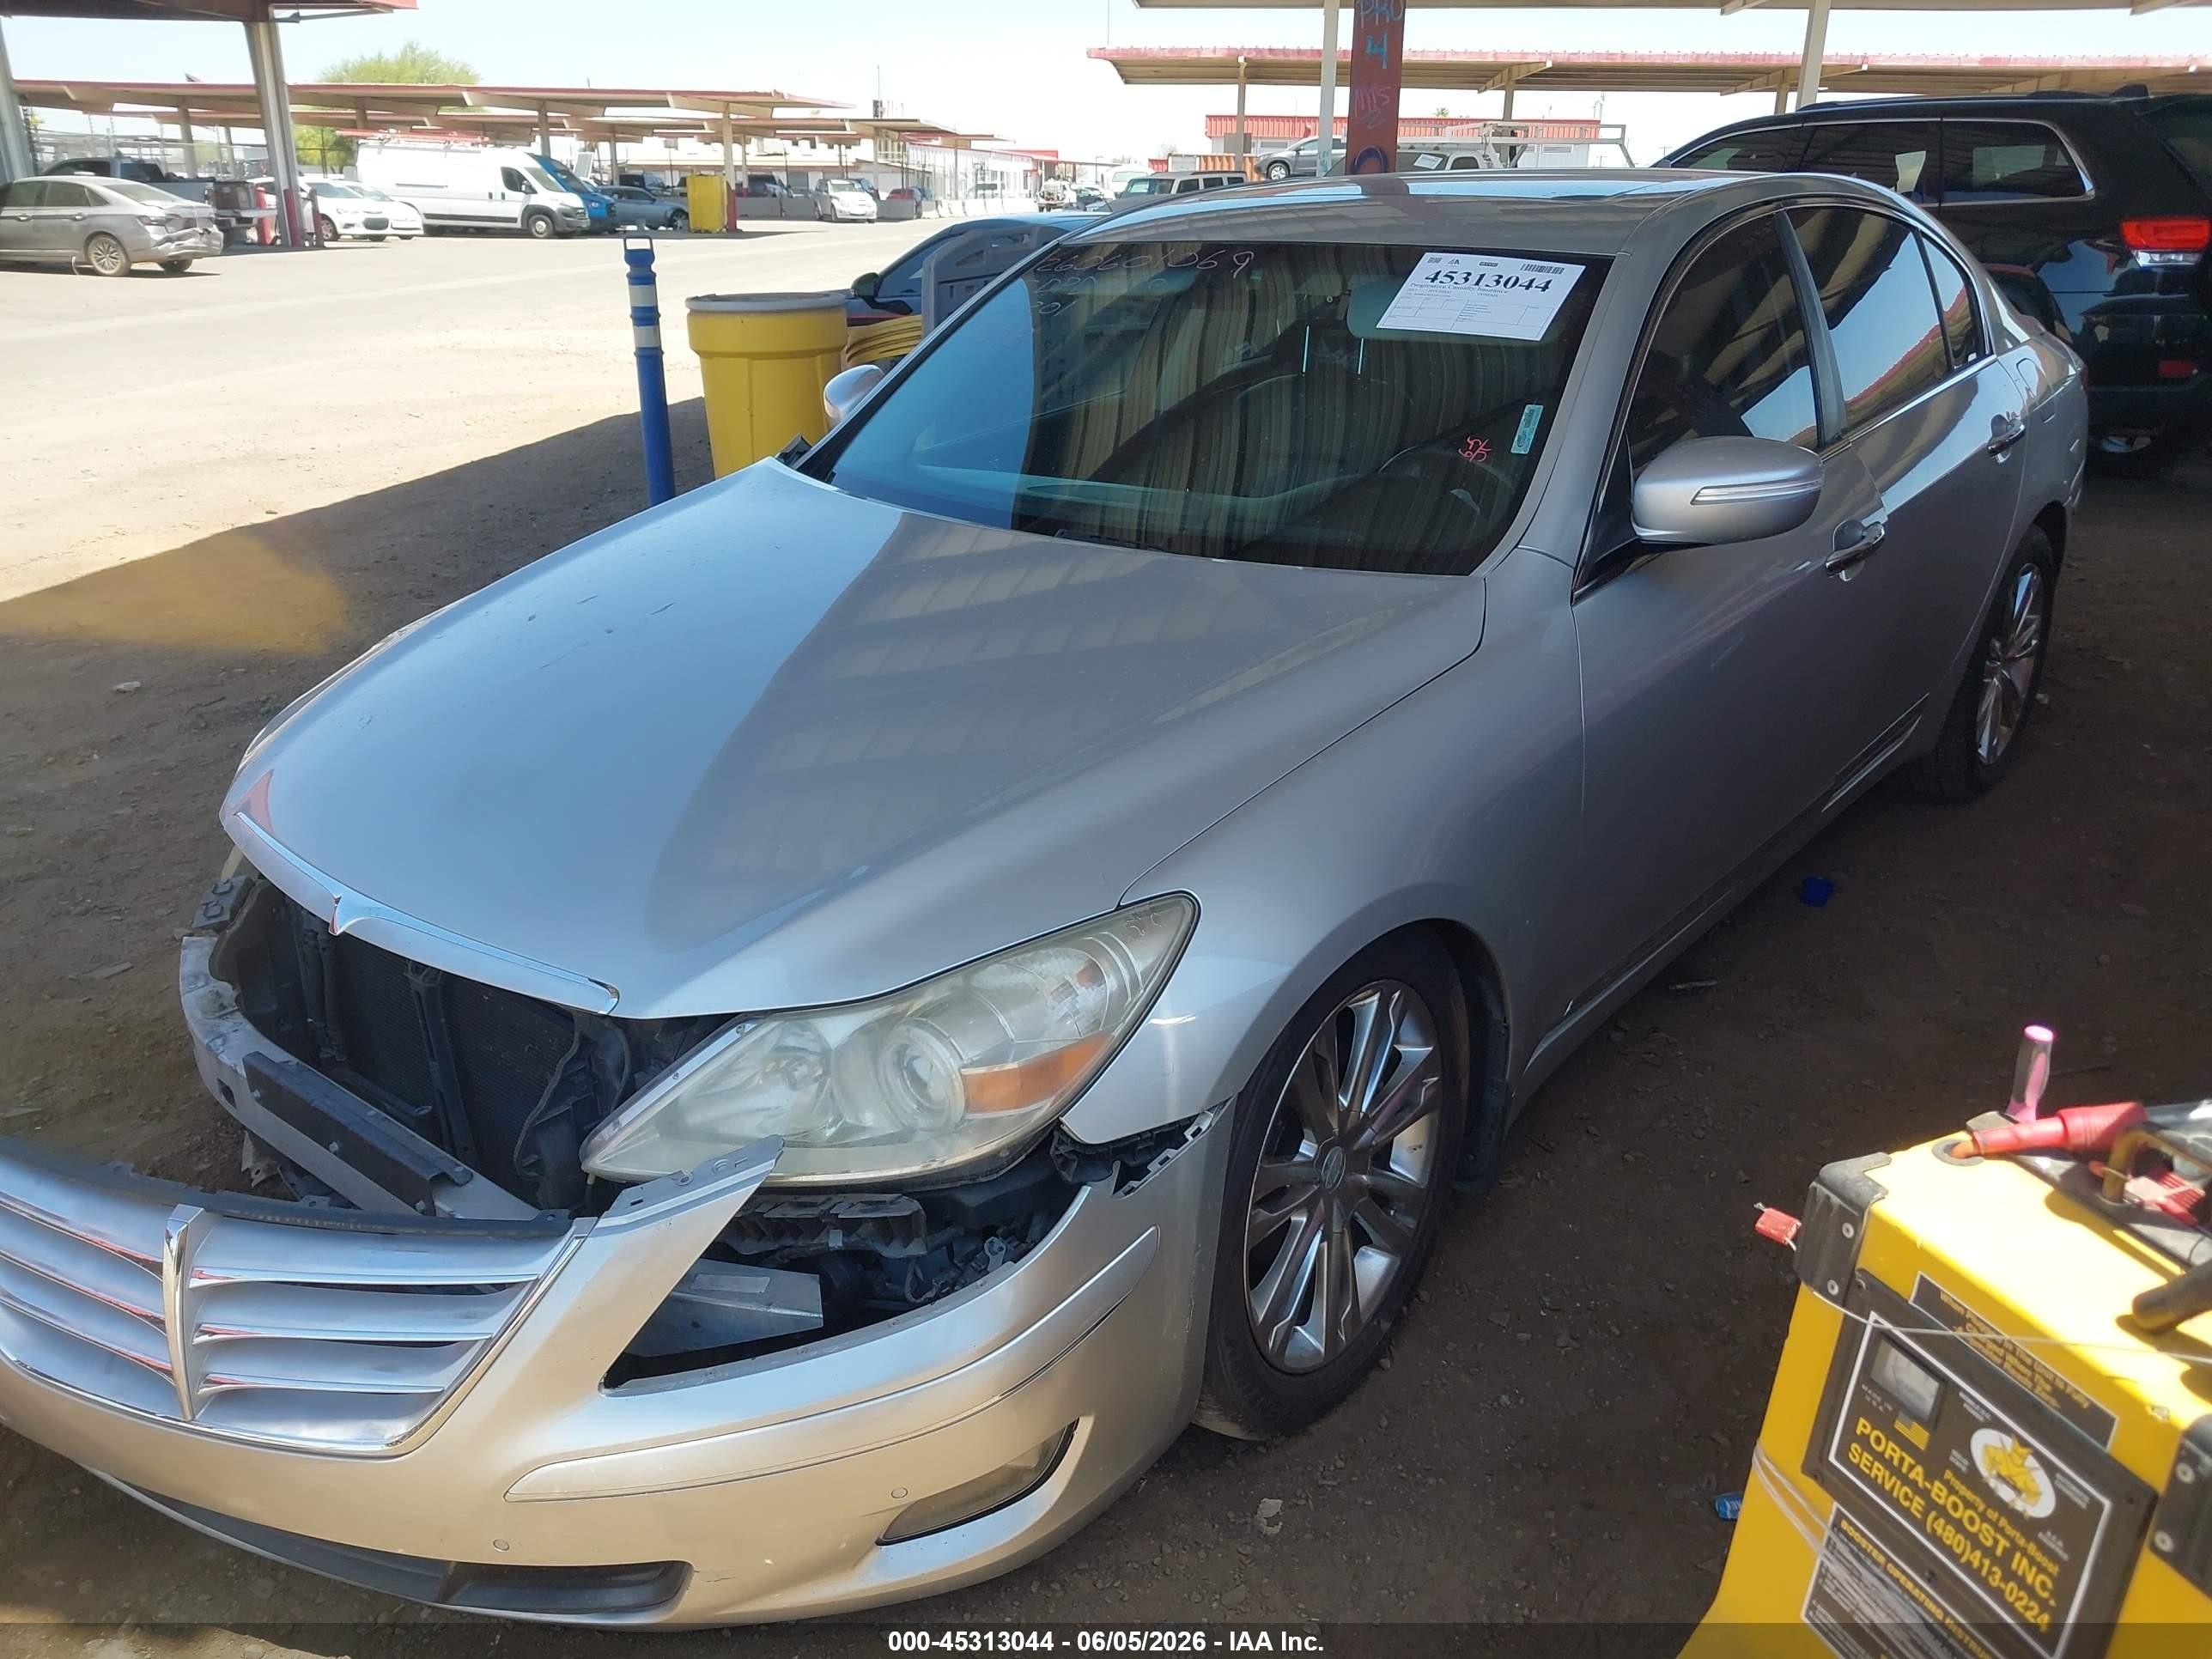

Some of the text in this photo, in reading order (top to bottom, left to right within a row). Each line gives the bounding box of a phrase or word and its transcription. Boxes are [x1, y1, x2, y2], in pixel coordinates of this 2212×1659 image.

[1425, 270, 1553, 292] 45313044
[1849, 1443, 1925, 1519] SERVICE
[1926, 1510, 2051, 1632] (480)413-0224
[1856, 1417, 2010, 1557] PORTA-BOOST
[2010, 1551, 2057, 1607] INC.
[1944, 1469, 1986, 1512] Property
[1986, 1508, 1999, 1522] of
[1998, 1516, 2059, 1577] Porta-Boost
[1840, 1517, 1887, 1569] BOOSTER
[1886, 1562, 1945, 1620] OPERATING
